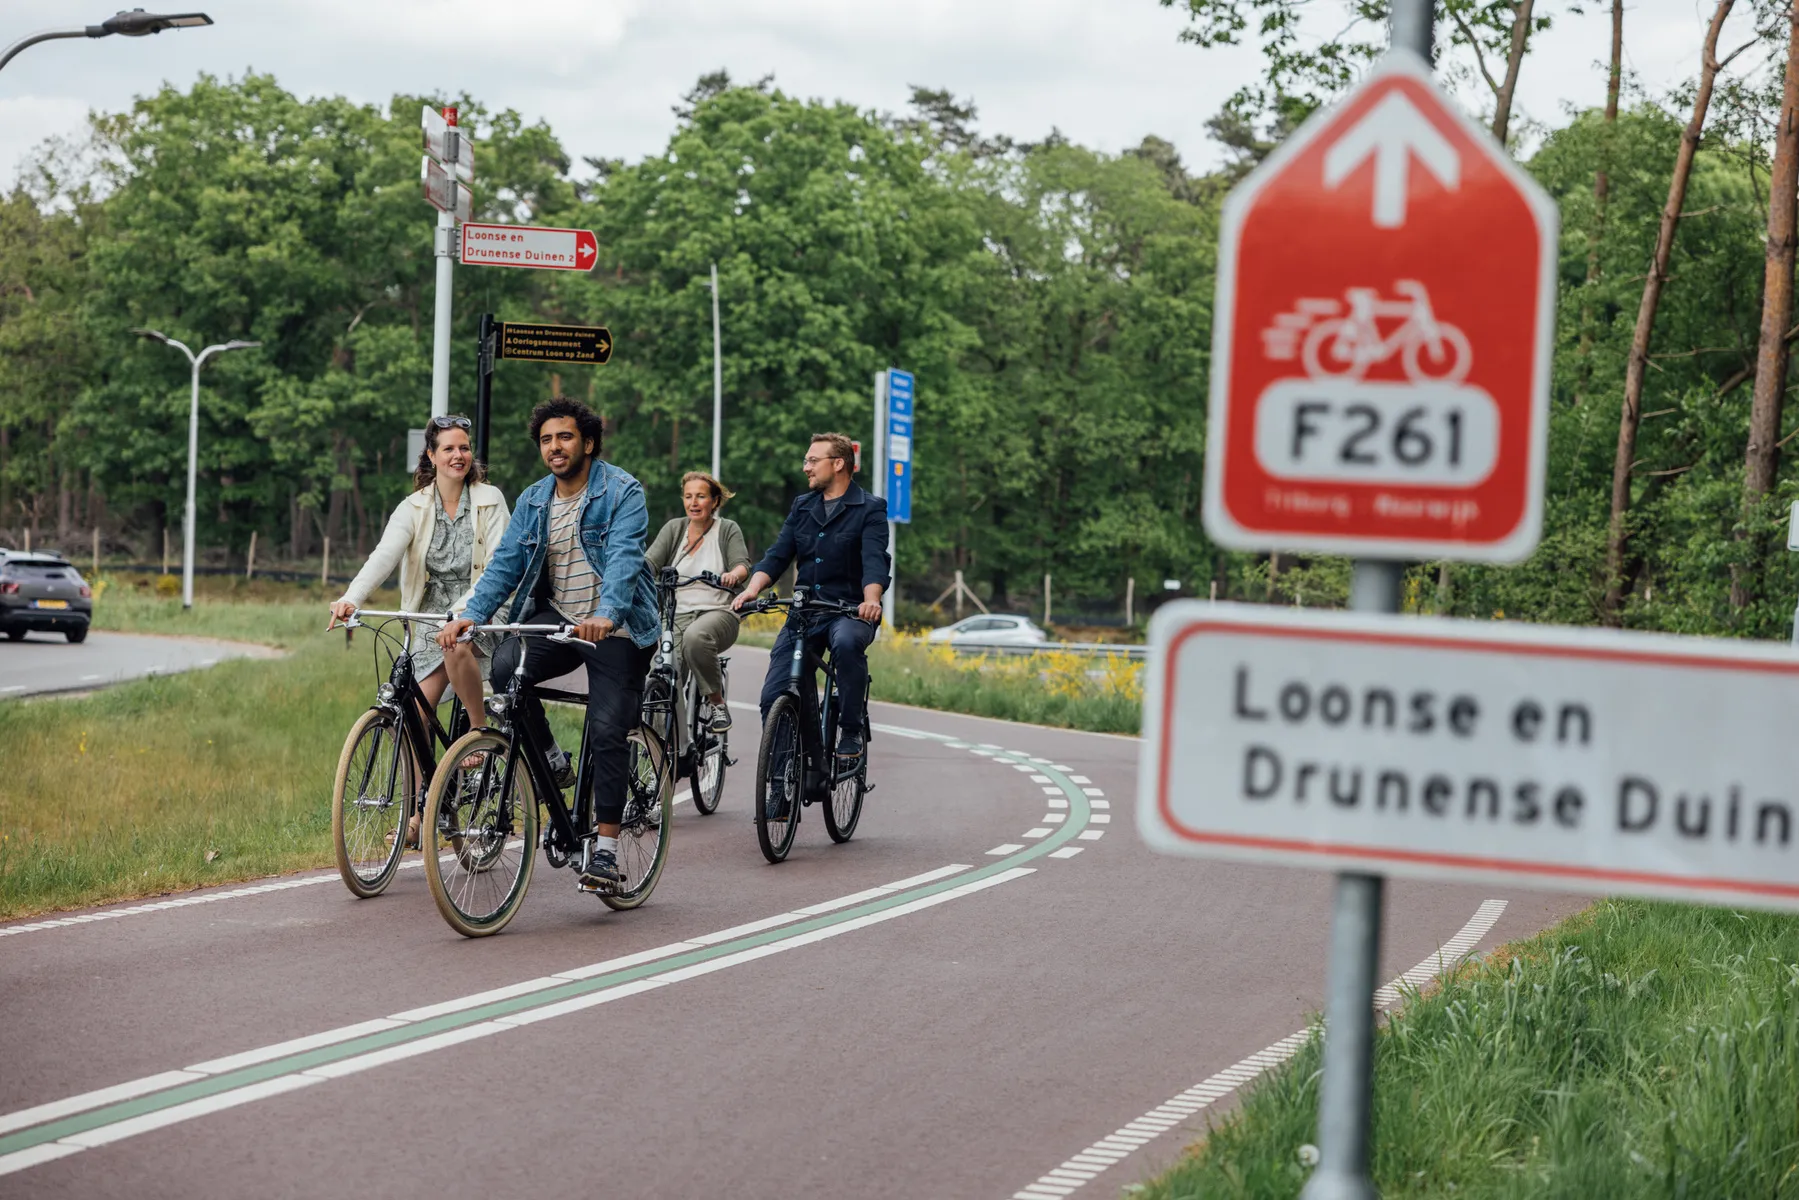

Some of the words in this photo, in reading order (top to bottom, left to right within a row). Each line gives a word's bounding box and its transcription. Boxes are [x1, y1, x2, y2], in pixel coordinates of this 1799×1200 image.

[468, 230, 507, 241] Loonse
[510, 234, 524, 242] en
[467, 247, 521, 258] Drunense
[525, 250, 565, 262] Duinen
[569, 255, 575, 263] 2
[512, 337, 581, 348] Oorlogsmonument
[512, 348, 544, 356] Centrum
[576, 351, 595, 359] Zand
[1290, 399, 1464, 468] F261
[1232, 666, 1481, 738] Loonse
[1510, 700, 1593, 744] en
[1242, 746, 1586, 828] Drunense
[1615, 773, 1795, 847] Duin
